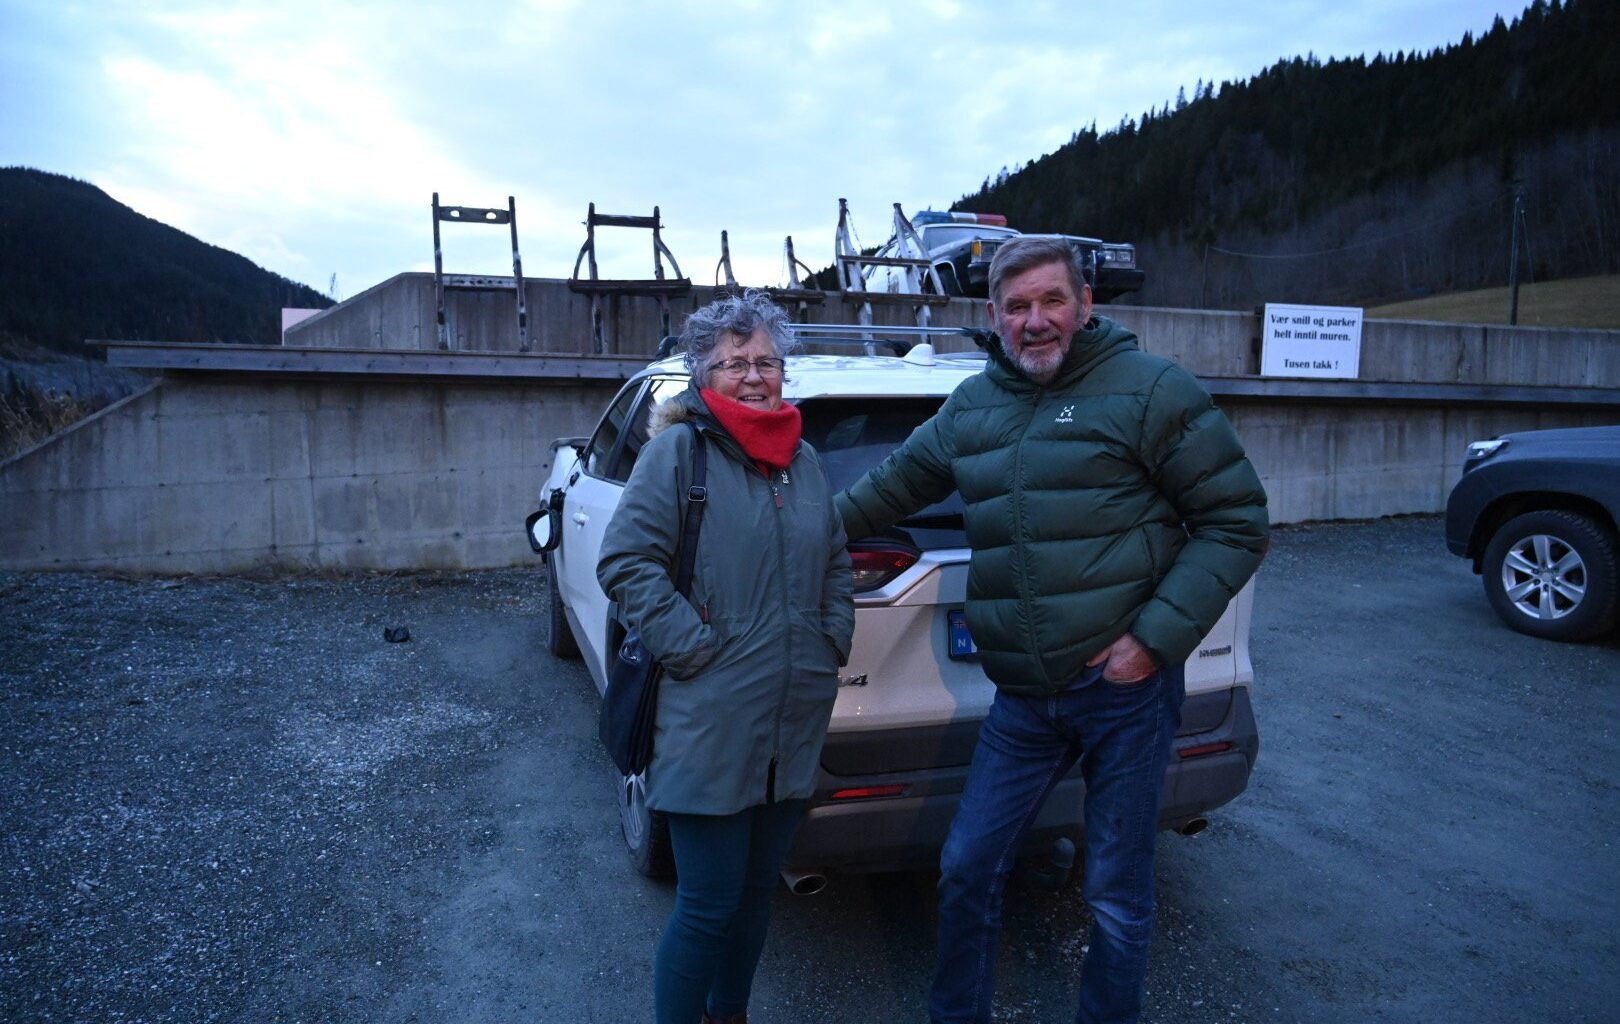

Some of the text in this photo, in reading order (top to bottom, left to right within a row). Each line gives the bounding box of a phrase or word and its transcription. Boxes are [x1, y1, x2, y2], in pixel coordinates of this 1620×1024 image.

[1271, 314, 1356, 328] Vær snill og parker
[1274, 329, 1351, 341] helt inntil muren.
[1284, 359, 1310, 369] Tusen
[1313, 360, 1332, 369] takk
[957, 638, 966, 648] N
